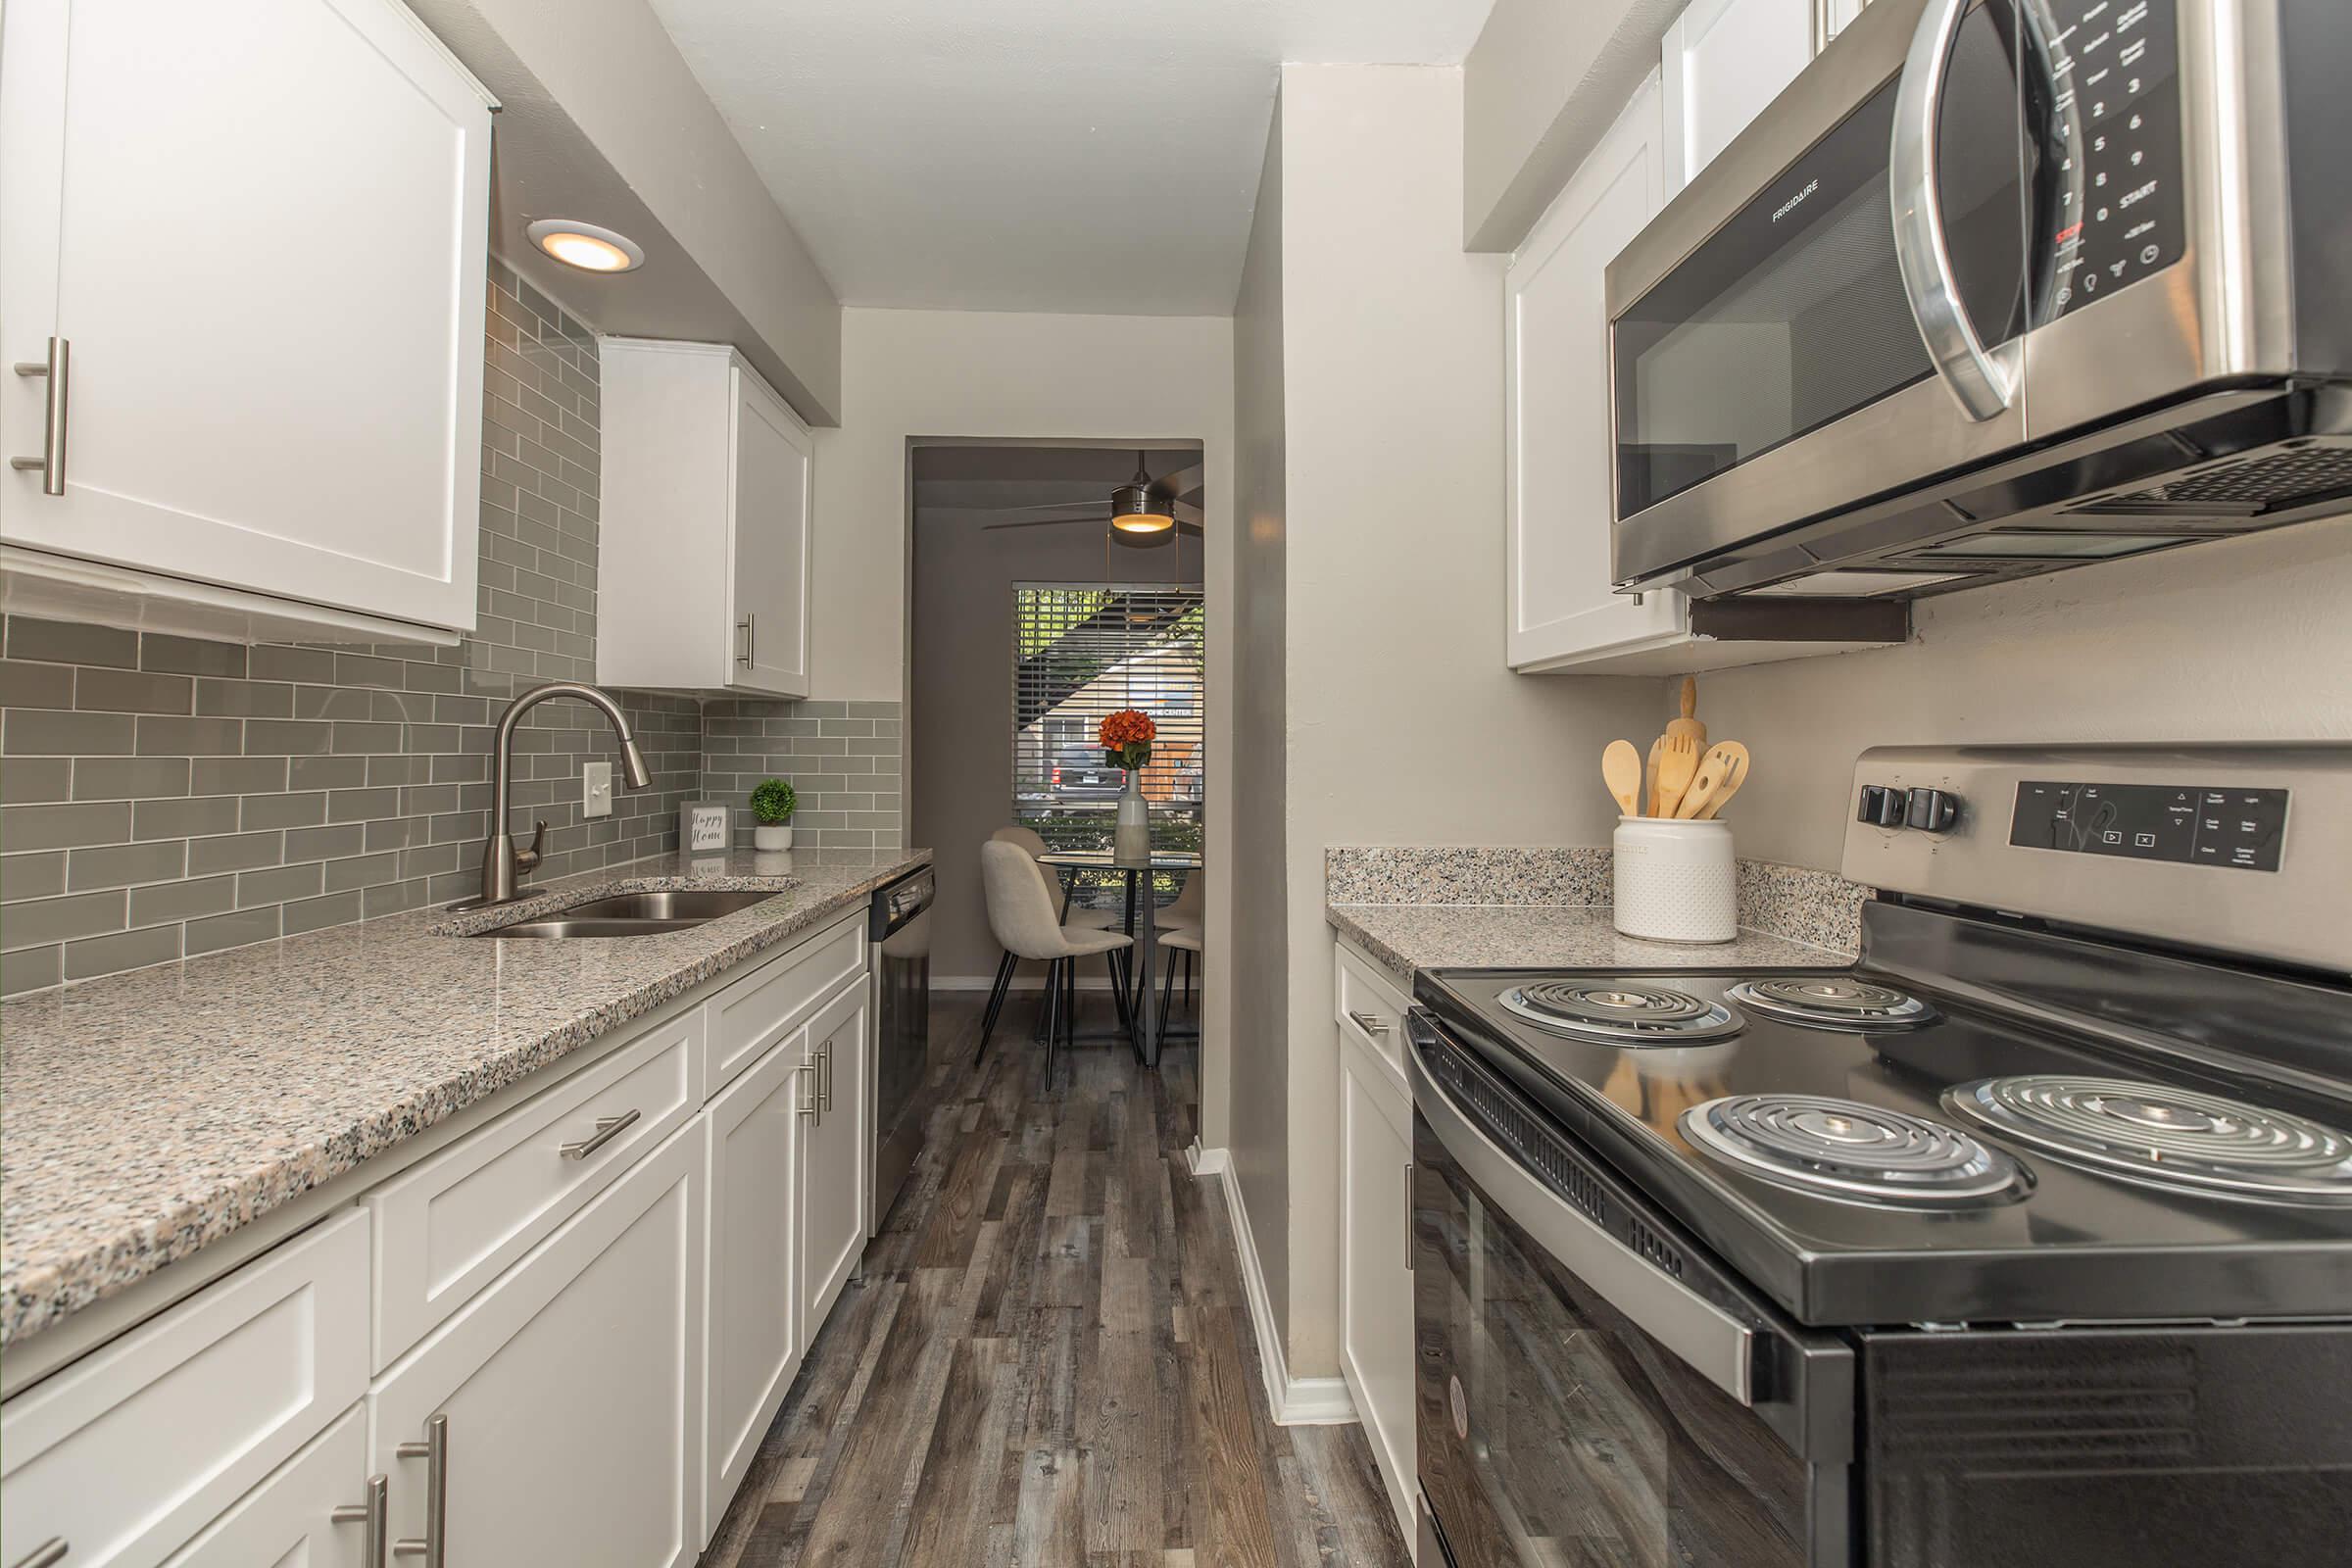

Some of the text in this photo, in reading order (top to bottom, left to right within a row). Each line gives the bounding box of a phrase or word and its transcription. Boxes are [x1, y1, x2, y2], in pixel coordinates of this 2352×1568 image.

[2128, 77, 2140, 93] 3
[2092, 101, 2105, 118] 2
[2061, 123, 2071, 137] 1
[2129, 114, 2142, 130] 6
[2094, 135, 2106, 152] 5
[2061, 157, 2072, 171] 4
[2131, 150, 2143, 167] 9
[2095, 172, 2107, 187] 8
[1772, 178, 1819, 223] FRIGIDAIRE
[2062, 191, 2074, 207] 7
[2119, 179, 2158, 210] START
[2096, 207, 2109, 222] 0
[690, 812, 722, 828] Happy
[692, 830, 720, 842] Home
